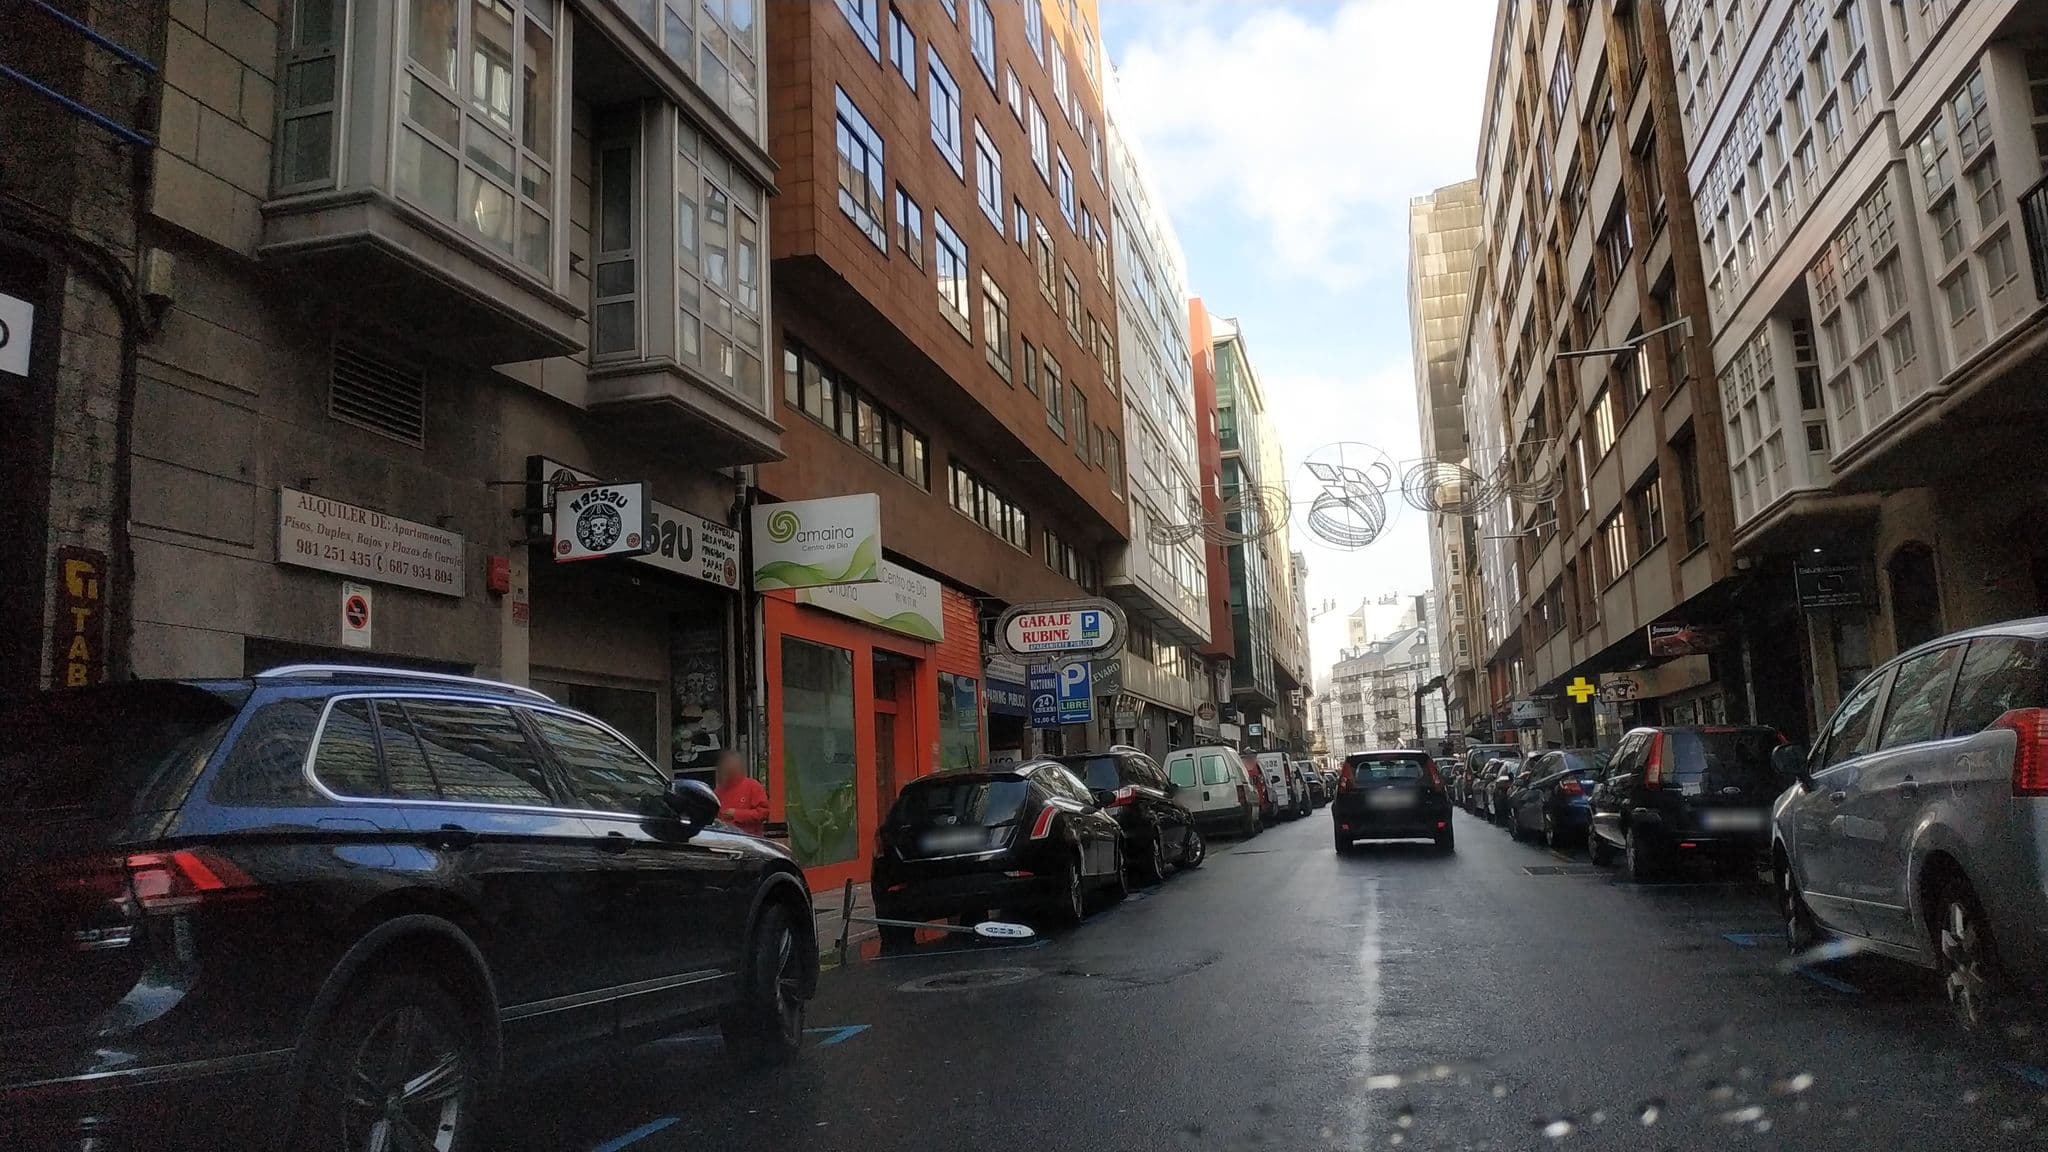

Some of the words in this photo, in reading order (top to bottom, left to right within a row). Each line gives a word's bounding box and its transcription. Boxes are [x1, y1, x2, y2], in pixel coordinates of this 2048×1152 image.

[298, 495, 367, 525] ALQUILER
[371, 513, 392, 530] DE:
[796, 525, 855, 543] amaina
[357, 532, 383, 549] Bajos
[392, 540, 420, 558] Plazas
[422, 547, 433, 561] de
[434, 551, 463, 568] Garaje
[802, 543, 825, 552] Centro
[826, 542, 836, 551] de
[296, 538, 319, 556] 981
[324, 544, 346, 562] 251
[350, 550, 371, 567] 435
[389, 559, 409, 576] 687
[412, 565, 432, 581] 934
[434, 569, 454, 585] 804
[702, 558, 723, 571] TAPAS
[702, 570, 722, 583] COPAS
[881, 567, 905, 590] Centro
[907, 577, 916, 593] de
[1018, 613, 1072, 629] GARAJE
[1084, 615, 1095, 628] P
[1023, 629, 1071, 644] RUBINE
[1030, 664, 1054, 675] ESTANCIA
[1093, 663, 1120, 683] EVARD
[1029, 678, 1056, 691] NOCTURNAS
[1061, 663, 1087, 697] P
[1038, 697, 1050, 708] 24
[1060, 700, 1089, 711] LIBRE
